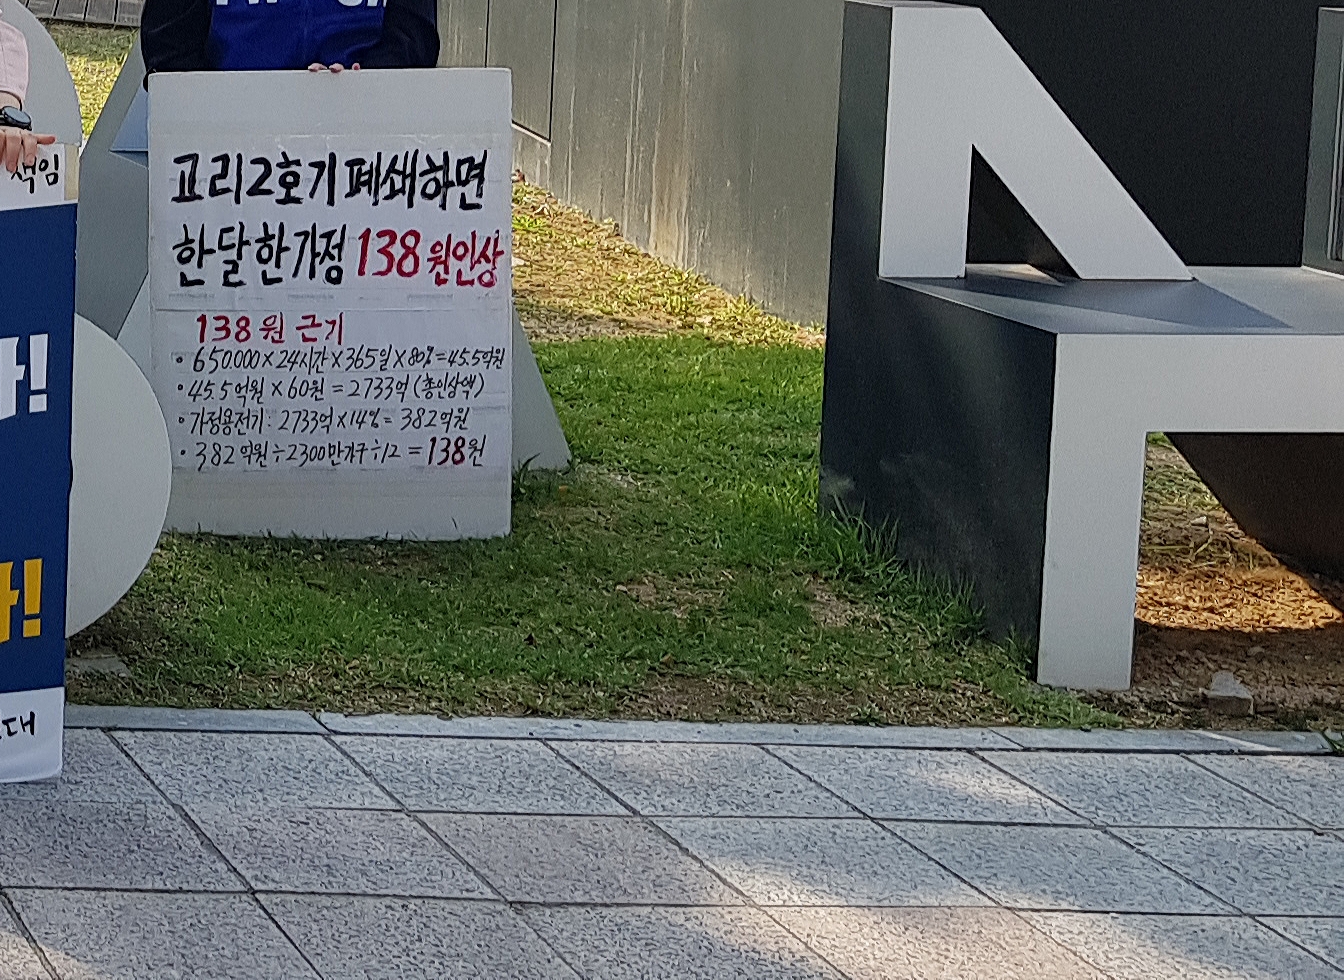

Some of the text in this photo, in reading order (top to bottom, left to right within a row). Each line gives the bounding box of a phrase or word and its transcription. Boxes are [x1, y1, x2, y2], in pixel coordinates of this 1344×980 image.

[10, 153, 61, 195] 책임
[170, 148, 488, 211] 고리2호기 폐쇄하면
